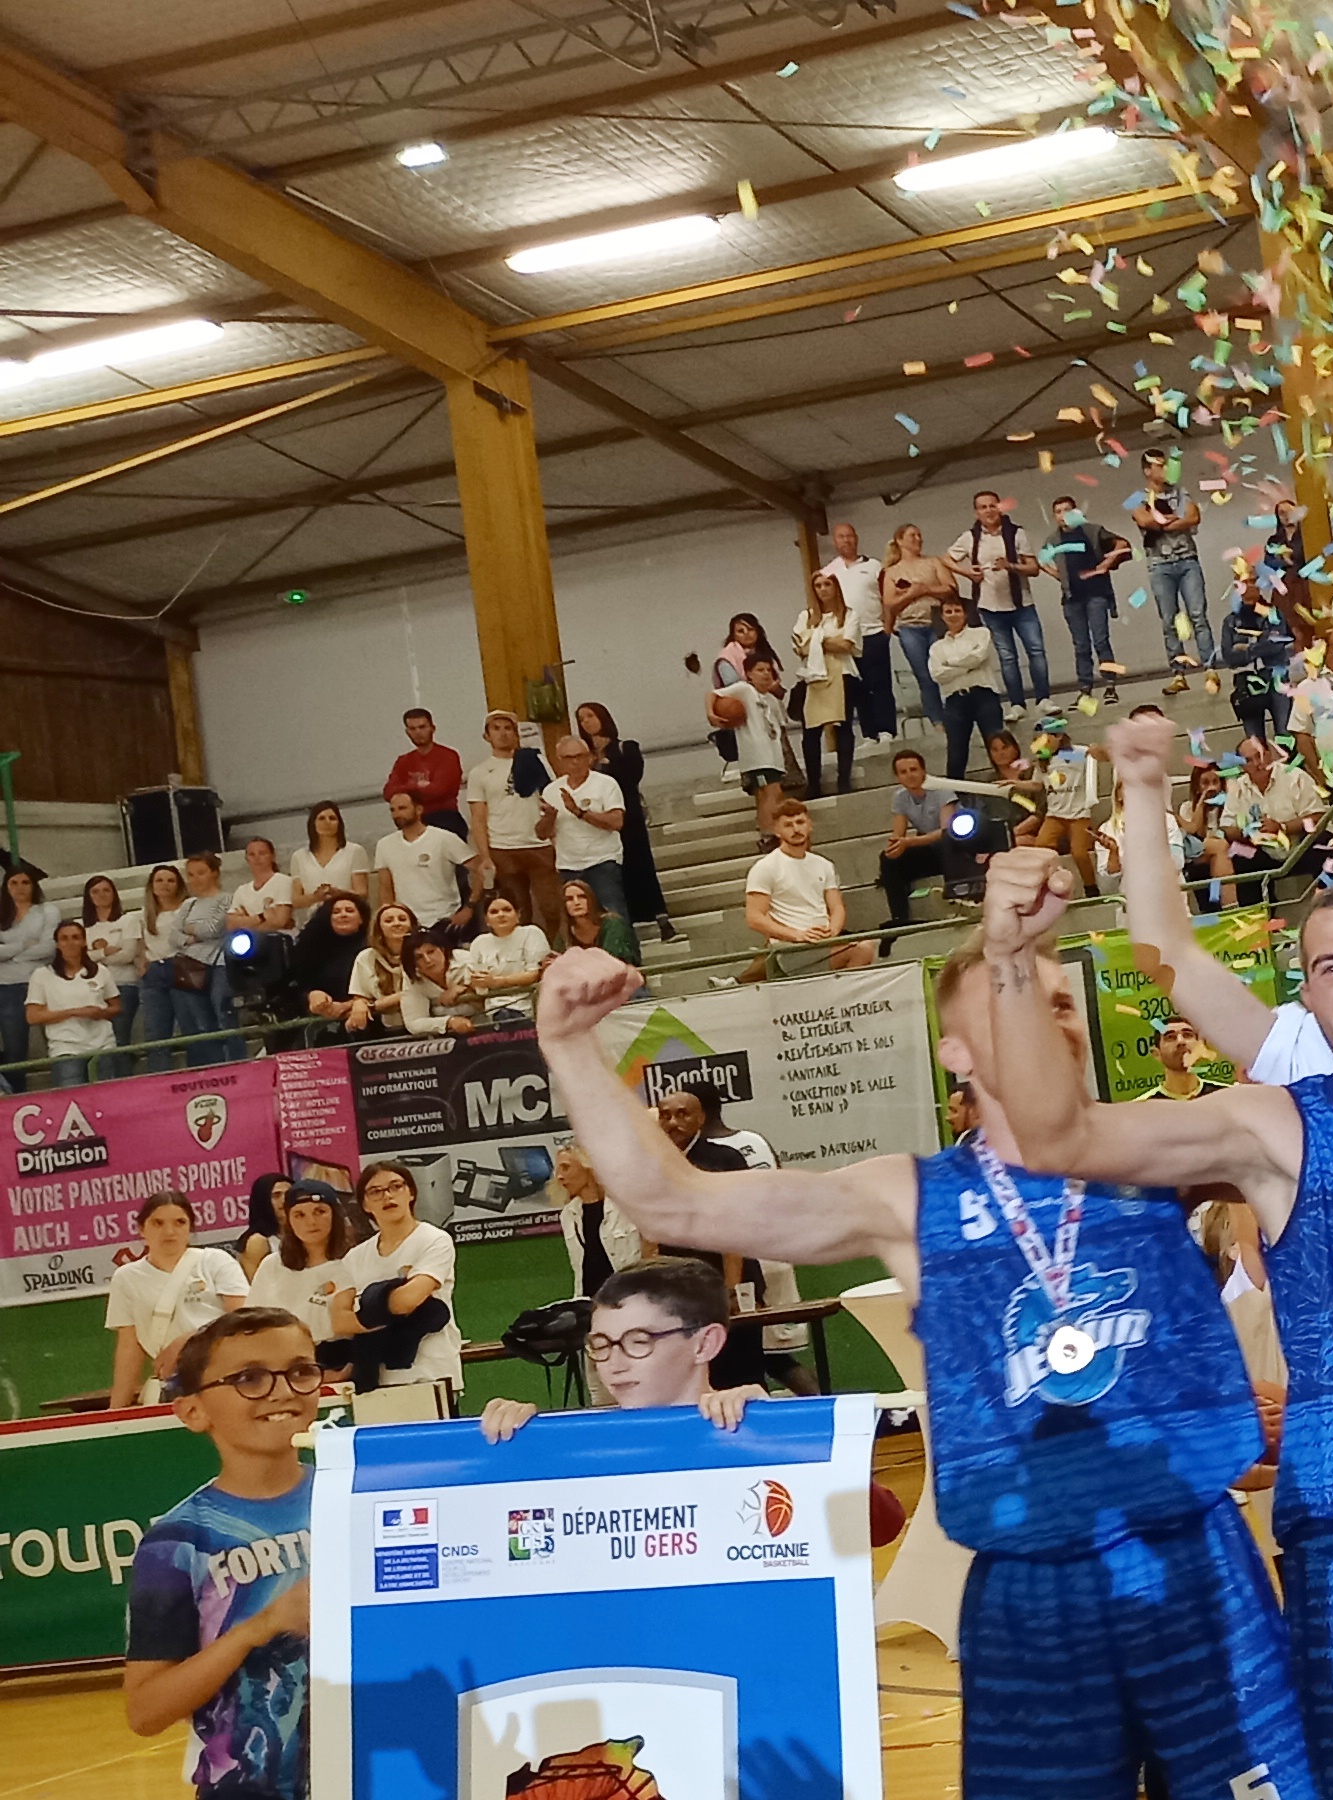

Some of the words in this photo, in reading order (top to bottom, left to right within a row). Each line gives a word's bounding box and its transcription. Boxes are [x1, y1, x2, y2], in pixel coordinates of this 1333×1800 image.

[780, 1006, 838, 1027] CARRELAGE
[856, 1037, 871, 1053] DE
[873, 1034, 895, 1050] SOLS
[387, 1066, 438, 1081] PARTENAIRE
[787, 1062, 841, 1082] SANITAIRE
[171, 1074, 238, 1095] BOUTIQUE
[361, 1078, 439, 1097] INFORMATIQUE
[789, 1083, 848, 1103] CONCEPTION
[850, 1079, 865, 1095] DE
[867, 1075, 897, 1092] SALLE
[393, 1110, 443, 1125] PARTENAIRE
[791, 1103, 806, 1118] DE
[807, 1101, 834, 1117] BAIN
[366, 1122, 445, 1141] COMMUNICATION
[17, 1143, 108, 1175] Diffusion
[7, 1182, 65, 1217] VOTRE
[69, 1165, 172, 1209] PARTENAIRE
[177, 1156, 247, 1193] SPORTIF
[13, 1220, 70, 1252] AUCH
[92, 1212, 121, 1242] 05
[222, 1194, 250, 1223] 05
[454, 1221, 482, 1233] Centre
[483, 1215, 533, 1231] commercial
[959, 1188, 998, 1241] 5
[484, 1228, 514, 1240] AUCH
[23, 1264, 95, 1294] SPALDING
[1005, 1313, 1150, 1403] JEUN
[562, 1504, 699, 1537] DÉPARTEMENT
[441, 1544, 480, 1558] CNDS
[610, 1534, 636, 1561] DU
[644, 1531, 699, 1558] GERS
[726, 1542, 810, 1562] OCCITANIE
[762, 1559, 810, 1568] BASKETBALL
